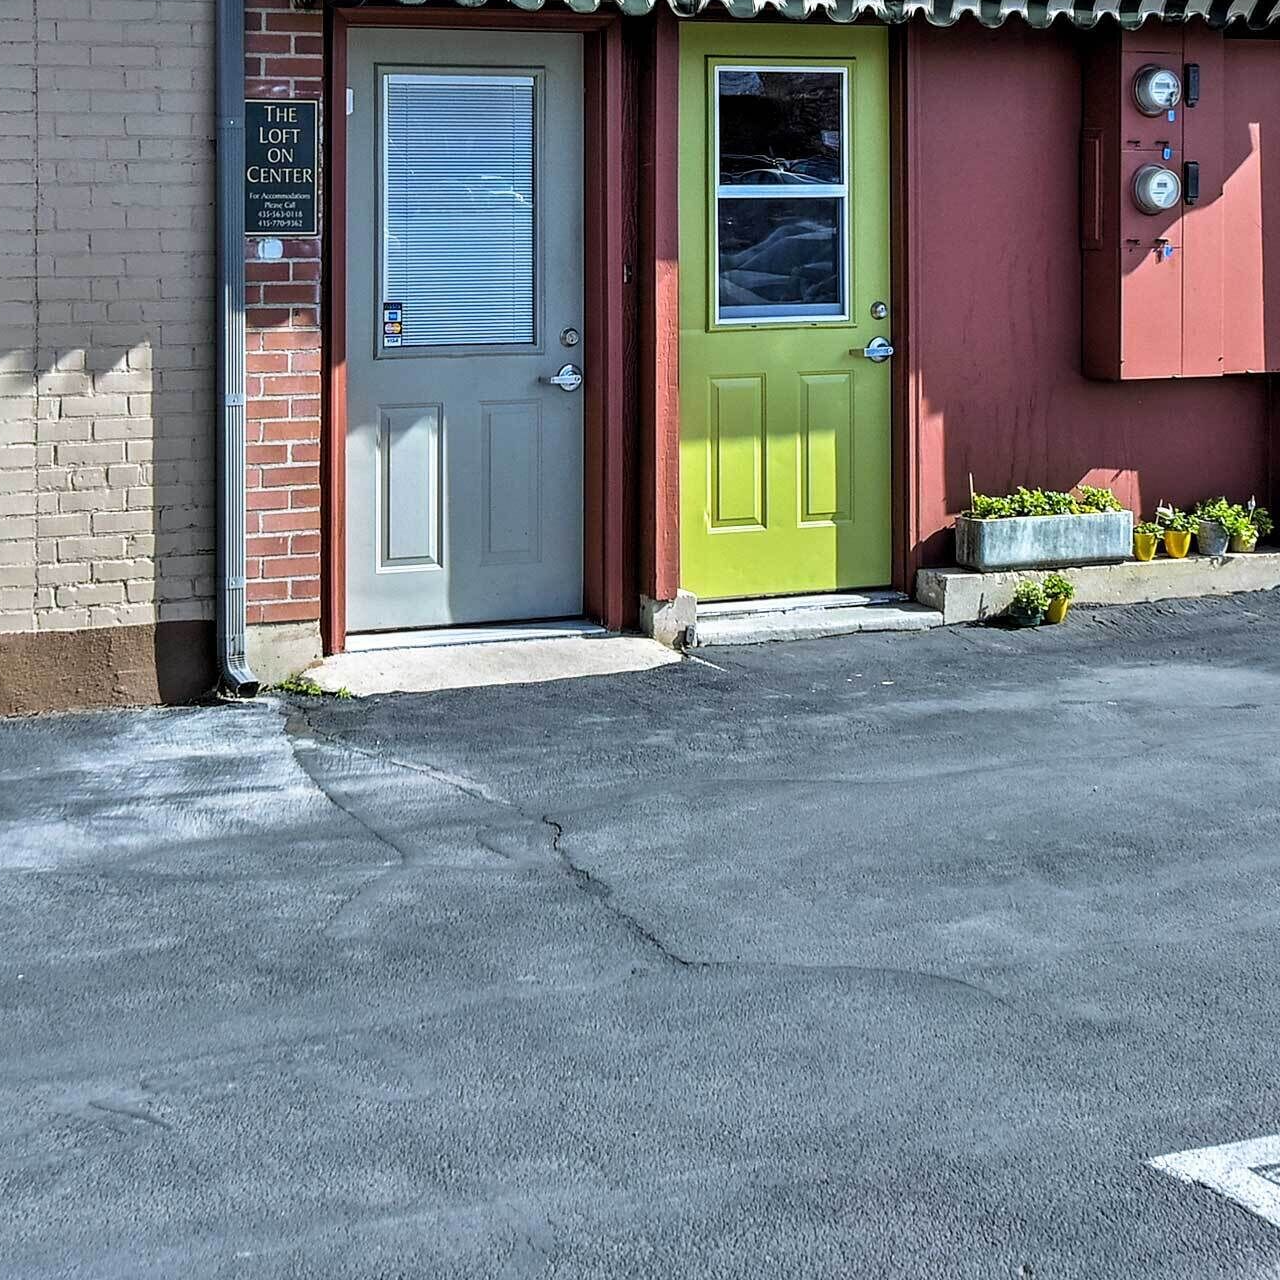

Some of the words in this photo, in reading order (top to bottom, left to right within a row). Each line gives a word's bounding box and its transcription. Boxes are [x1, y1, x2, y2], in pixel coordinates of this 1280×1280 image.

[263, 105, 298, 122] THE
[259, 126, 301, 143] LOFT
[267, 147, 294, 163] ON
[246, 166, 313, 183] CENTER
[249, 192, 260, 200] For
[284, 201, 296, 209] Call
